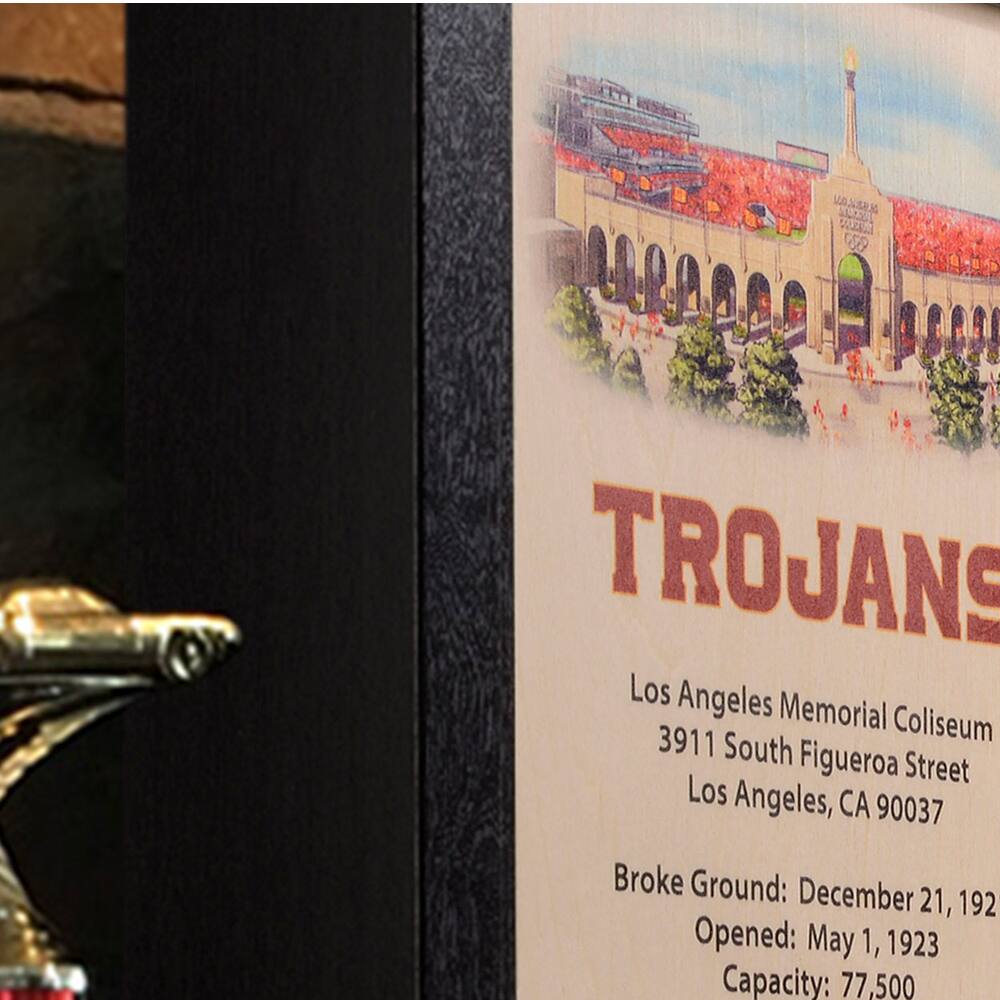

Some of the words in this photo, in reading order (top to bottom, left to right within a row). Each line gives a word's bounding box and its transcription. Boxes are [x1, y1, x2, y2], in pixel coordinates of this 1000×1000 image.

[630, 672, 671, 706] Los
[677, 679, 773, 721] Angeles
[780, 690, 887, 731] Memorial
[893, 704, 993, 743] Coliseum
[658, 724, 714, 758] 3911
[724, 730, 793, 766] South
[800, 738, 899, 777] Figueroa
[905, 750, 970, 784] Street
[688, 773, 728, 808] Los
[734, 778, 833, 820] Angeles,
[839, 788, 871, 820] CA
[876, 792, 944, 826] 90037
[614, 862, 684, 896] Broke
[690, 868, 787, 904] Ground:
[799, 876, 915, 914] December
[919, 886, 952, 919] 21,
[694, 915, 796, 953] Opened:
[807, 922, 855, 961] May
[862, 927, 880, 959] 1,
[887, 928, 939, 959] 1923
